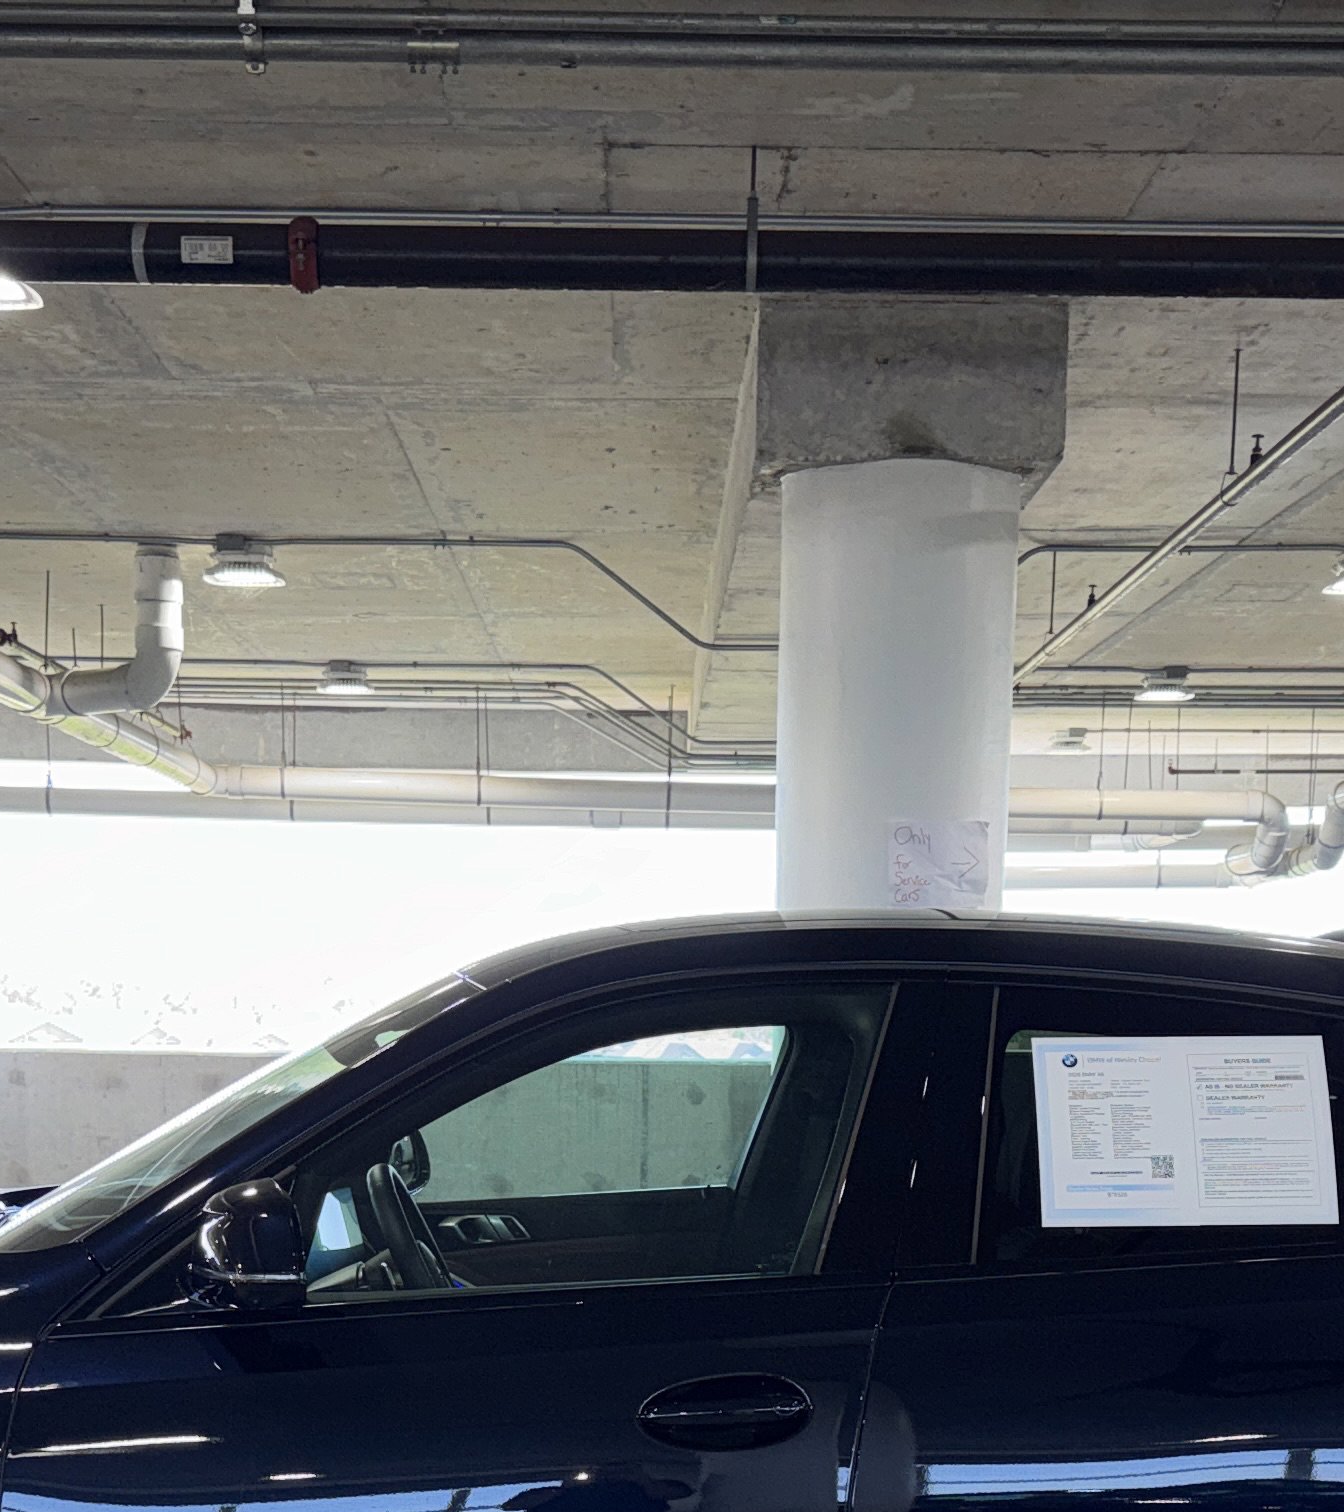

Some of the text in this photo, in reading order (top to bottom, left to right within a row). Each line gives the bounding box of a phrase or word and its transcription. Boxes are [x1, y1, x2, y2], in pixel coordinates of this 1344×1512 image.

[894, 826, 931, 853] Only
[893, 854, 912, 870] for
[894, 871, 931, 887] Service
[894, 889, 920, 903] Cars
